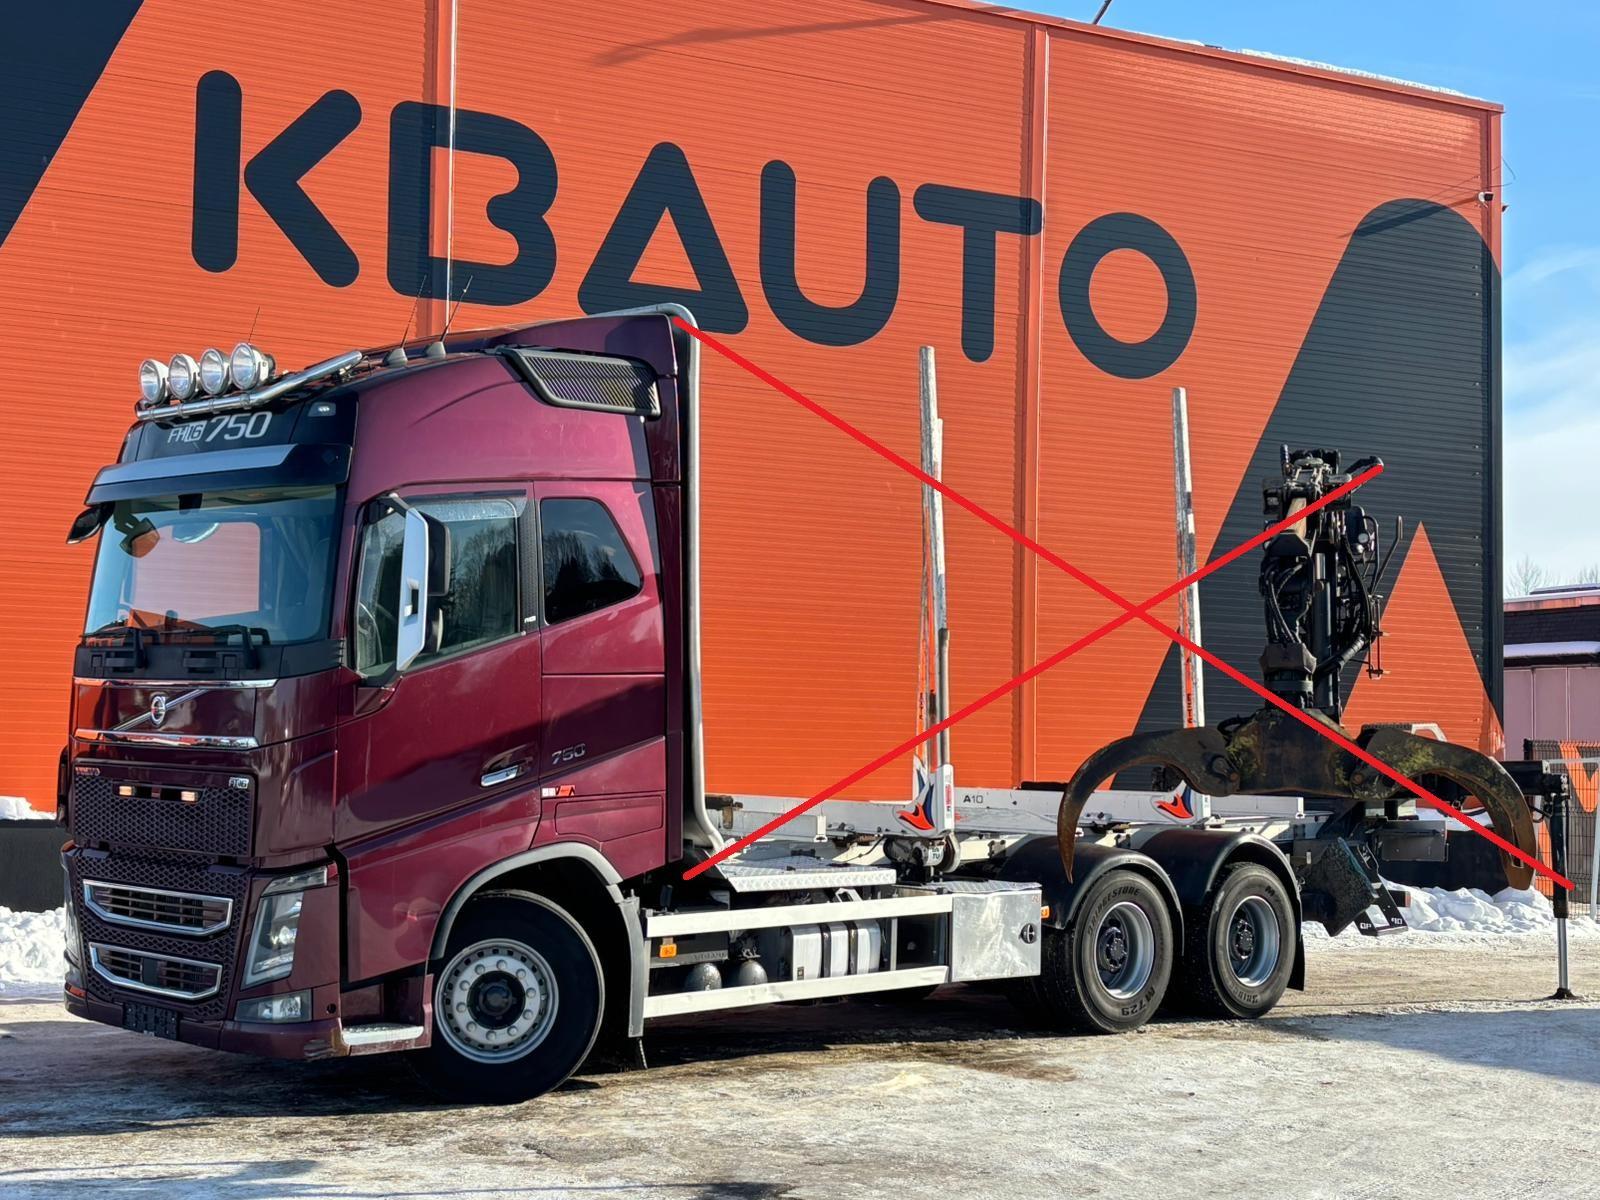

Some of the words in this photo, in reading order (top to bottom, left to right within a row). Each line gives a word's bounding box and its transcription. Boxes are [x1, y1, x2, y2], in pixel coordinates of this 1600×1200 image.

[192, 70, 1196, 379] KBAUTO
[205, 411, 273, 442] 750
[551, 743, 586, 765] 750
[963, 795, 984, 804] A10
